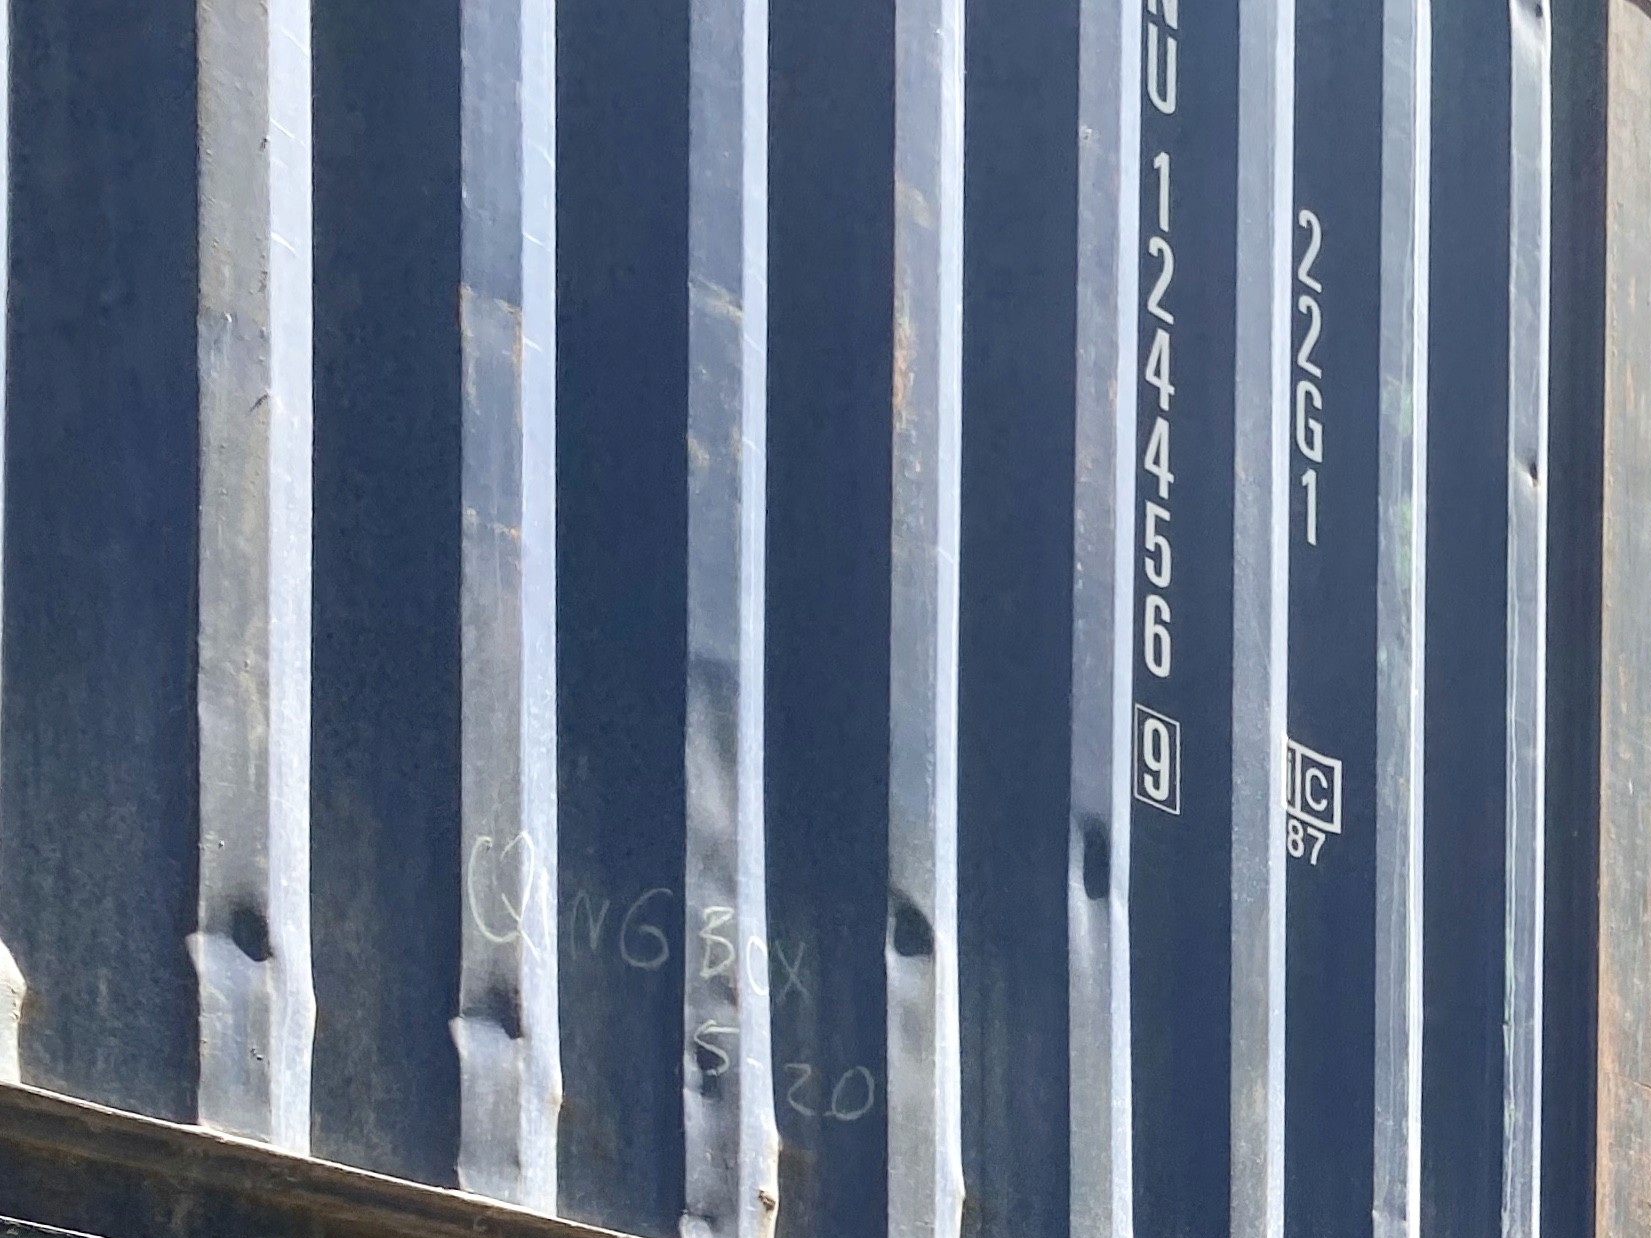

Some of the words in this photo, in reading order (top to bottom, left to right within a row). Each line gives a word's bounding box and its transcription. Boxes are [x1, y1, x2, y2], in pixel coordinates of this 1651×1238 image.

[1143, 151, 1175, 678] 124456
[1296, 208, 1324, 546] 22G1
[1143, 717, 1170, 801] 9
[1286, 818, 1327, 866] 87
